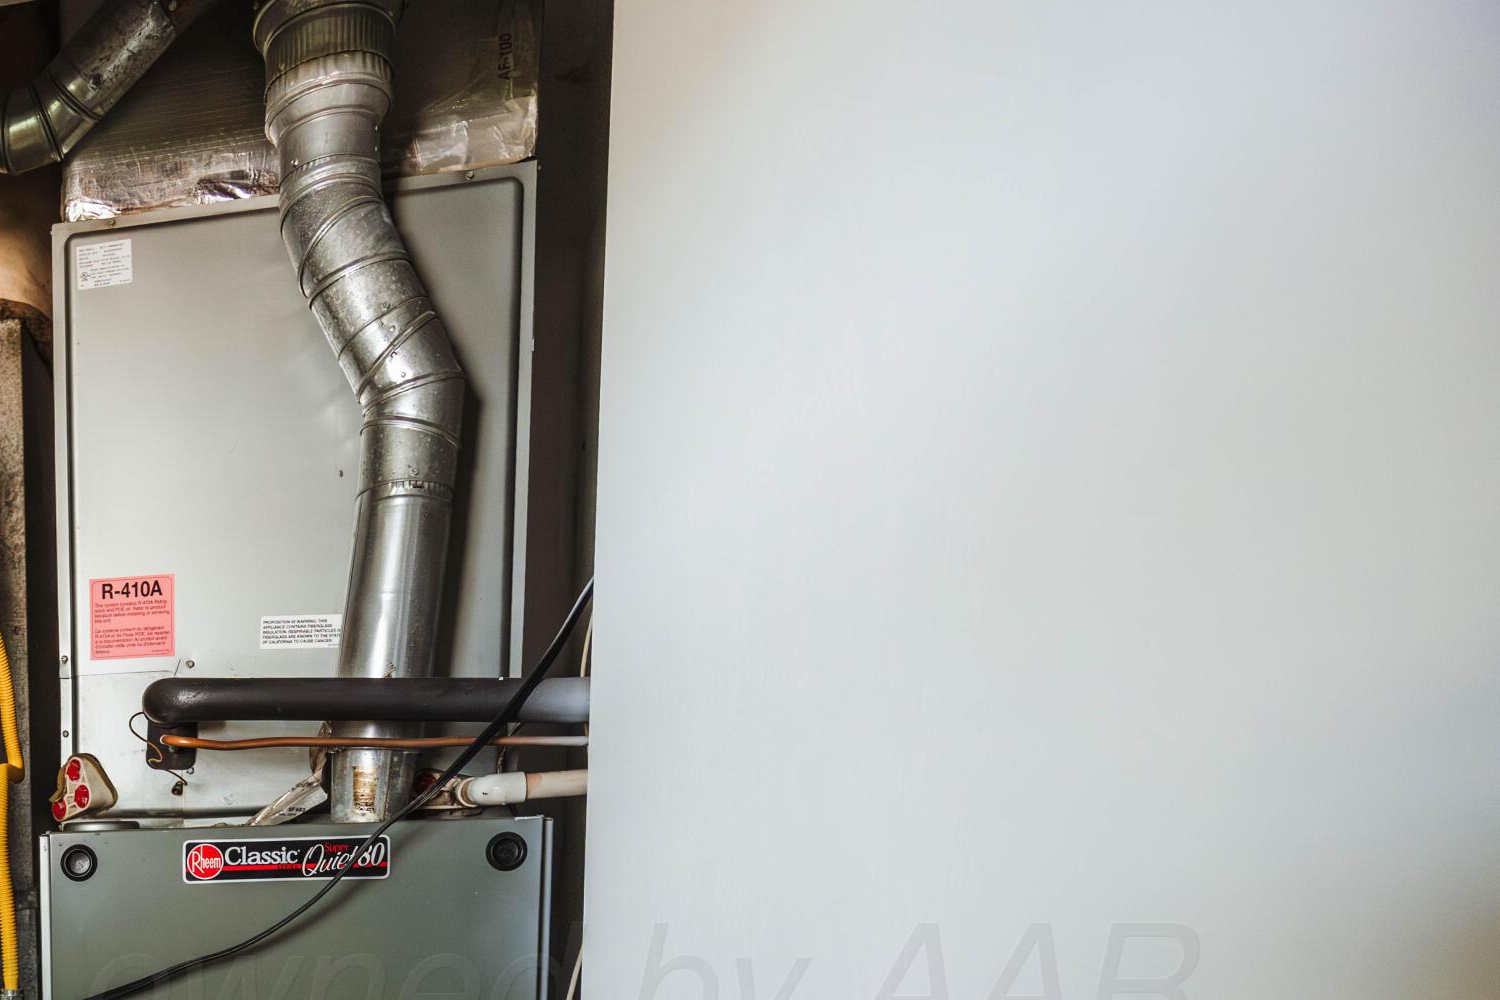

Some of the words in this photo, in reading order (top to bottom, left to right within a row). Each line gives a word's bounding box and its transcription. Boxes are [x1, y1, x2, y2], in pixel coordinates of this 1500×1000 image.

[101, 580, 163, 600] R-410A
[225, 846, 298, 866] Classic
[324, 842, 349, 853] Super
[192, 844, 221, 873] Rheem
